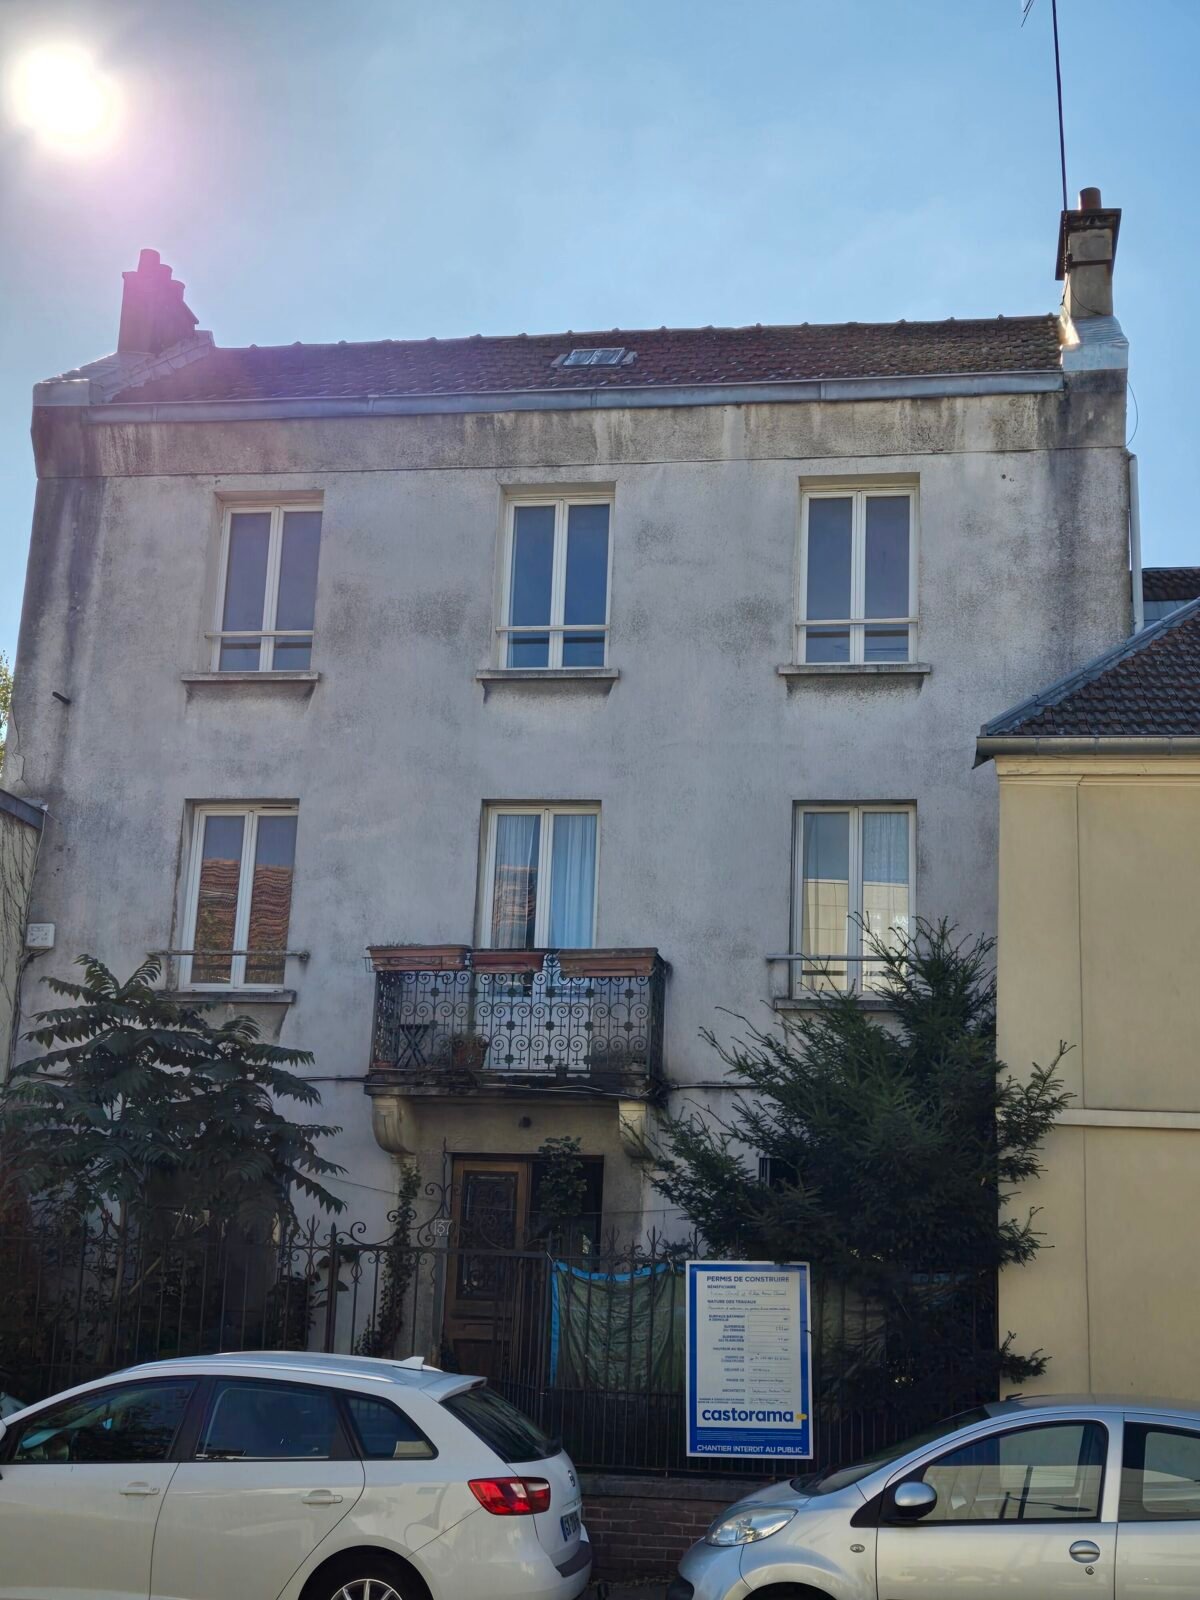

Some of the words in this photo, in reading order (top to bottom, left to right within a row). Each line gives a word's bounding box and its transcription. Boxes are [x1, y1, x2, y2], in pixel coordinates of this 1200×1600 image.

[434, 1220, 453, 1236] 137
[702, 1407, 794, 1422] castorama
[697, 1444, 732, 1452] CHANTIER
[733, 1445, 764, 1453] INTERDIT
[777, 1446, 803, 1454] PUBLIC
